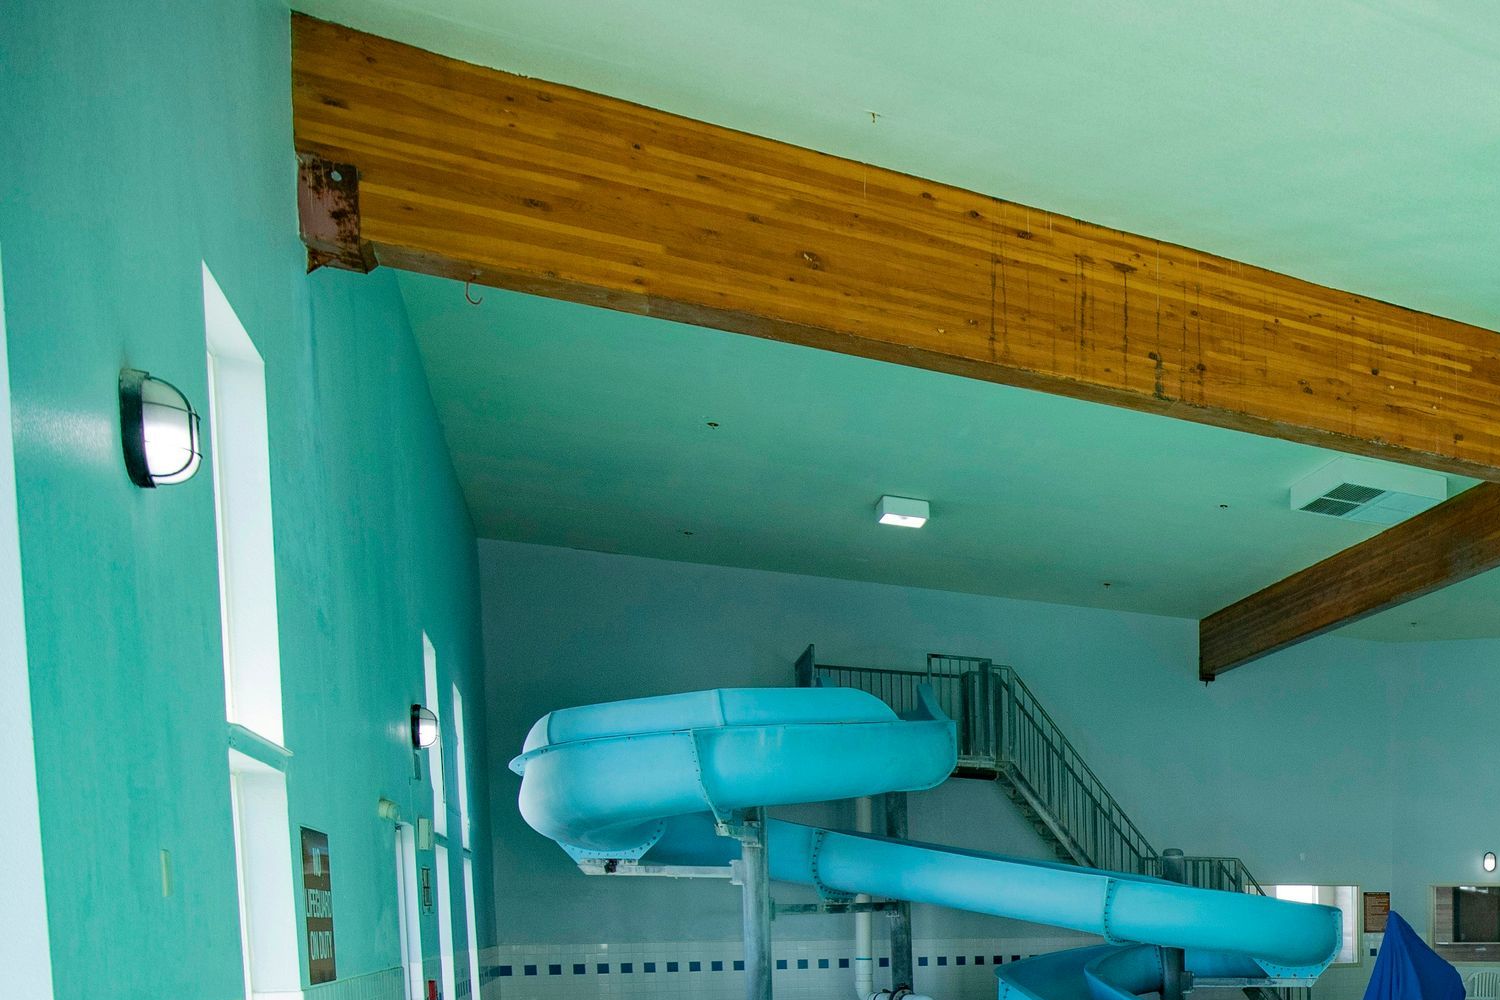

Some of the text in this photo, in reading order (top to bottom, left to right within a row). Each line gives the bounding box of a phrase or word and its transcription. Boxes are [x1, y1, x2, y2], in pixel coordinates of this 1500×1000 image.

[312, 847, 322, 877] NO
[310, 931, 333, 960] ON DUTY
